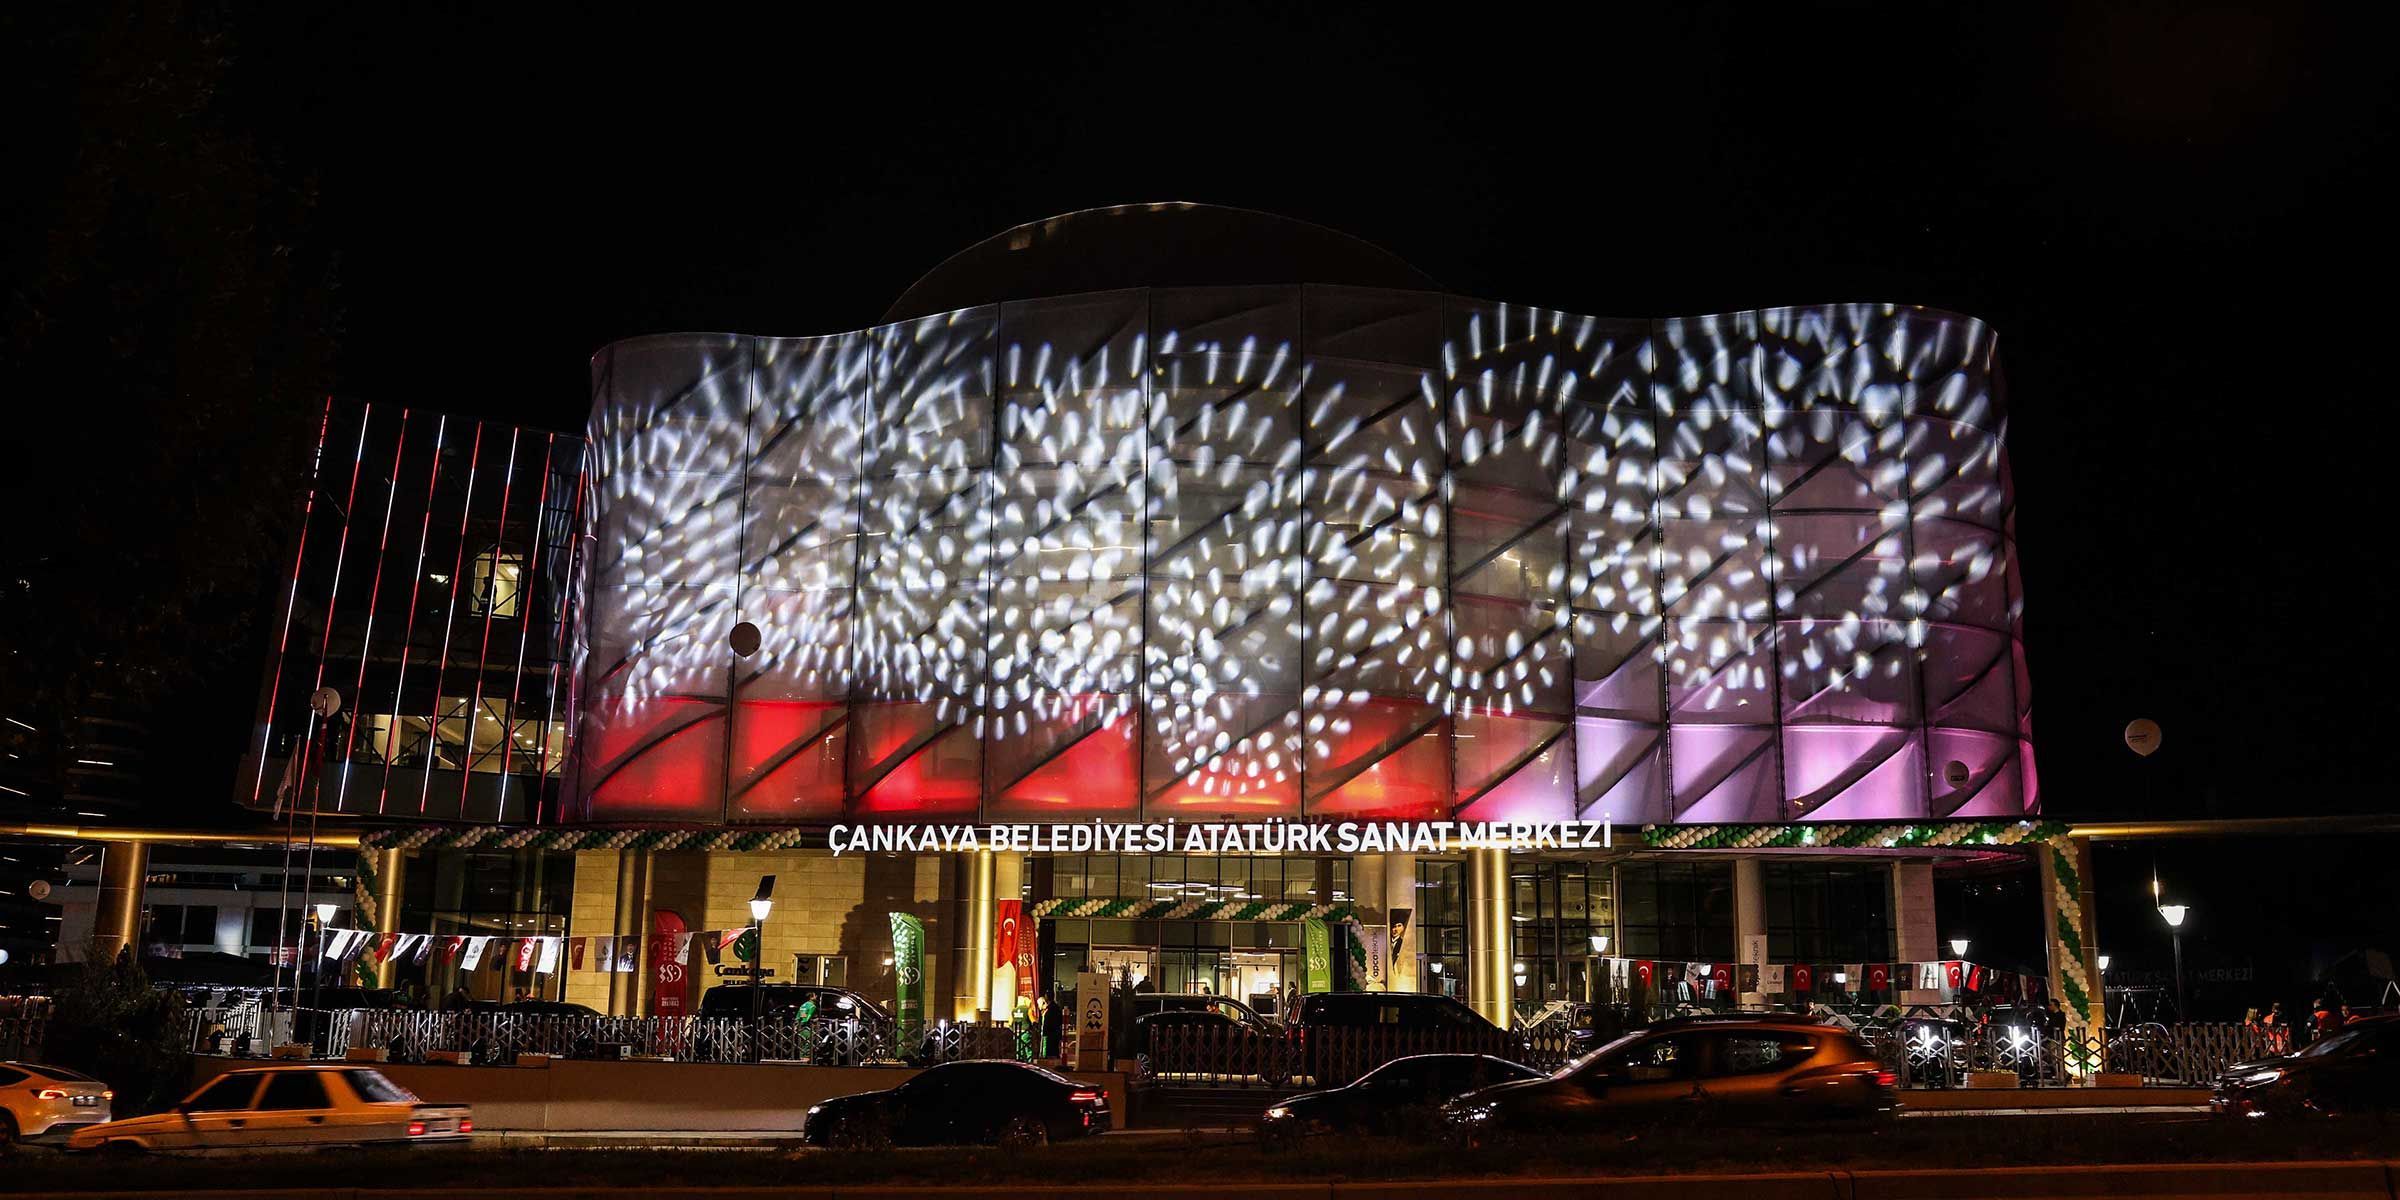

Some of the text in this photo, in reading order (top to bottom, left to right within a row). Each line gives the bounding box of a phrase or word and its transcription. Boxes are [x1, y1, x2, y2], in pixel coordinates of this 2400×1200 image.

[829, 812, 1612, 857] ÇANKAYA BELEDİYESİ ATATÜRK SANAT MERKEZİ
